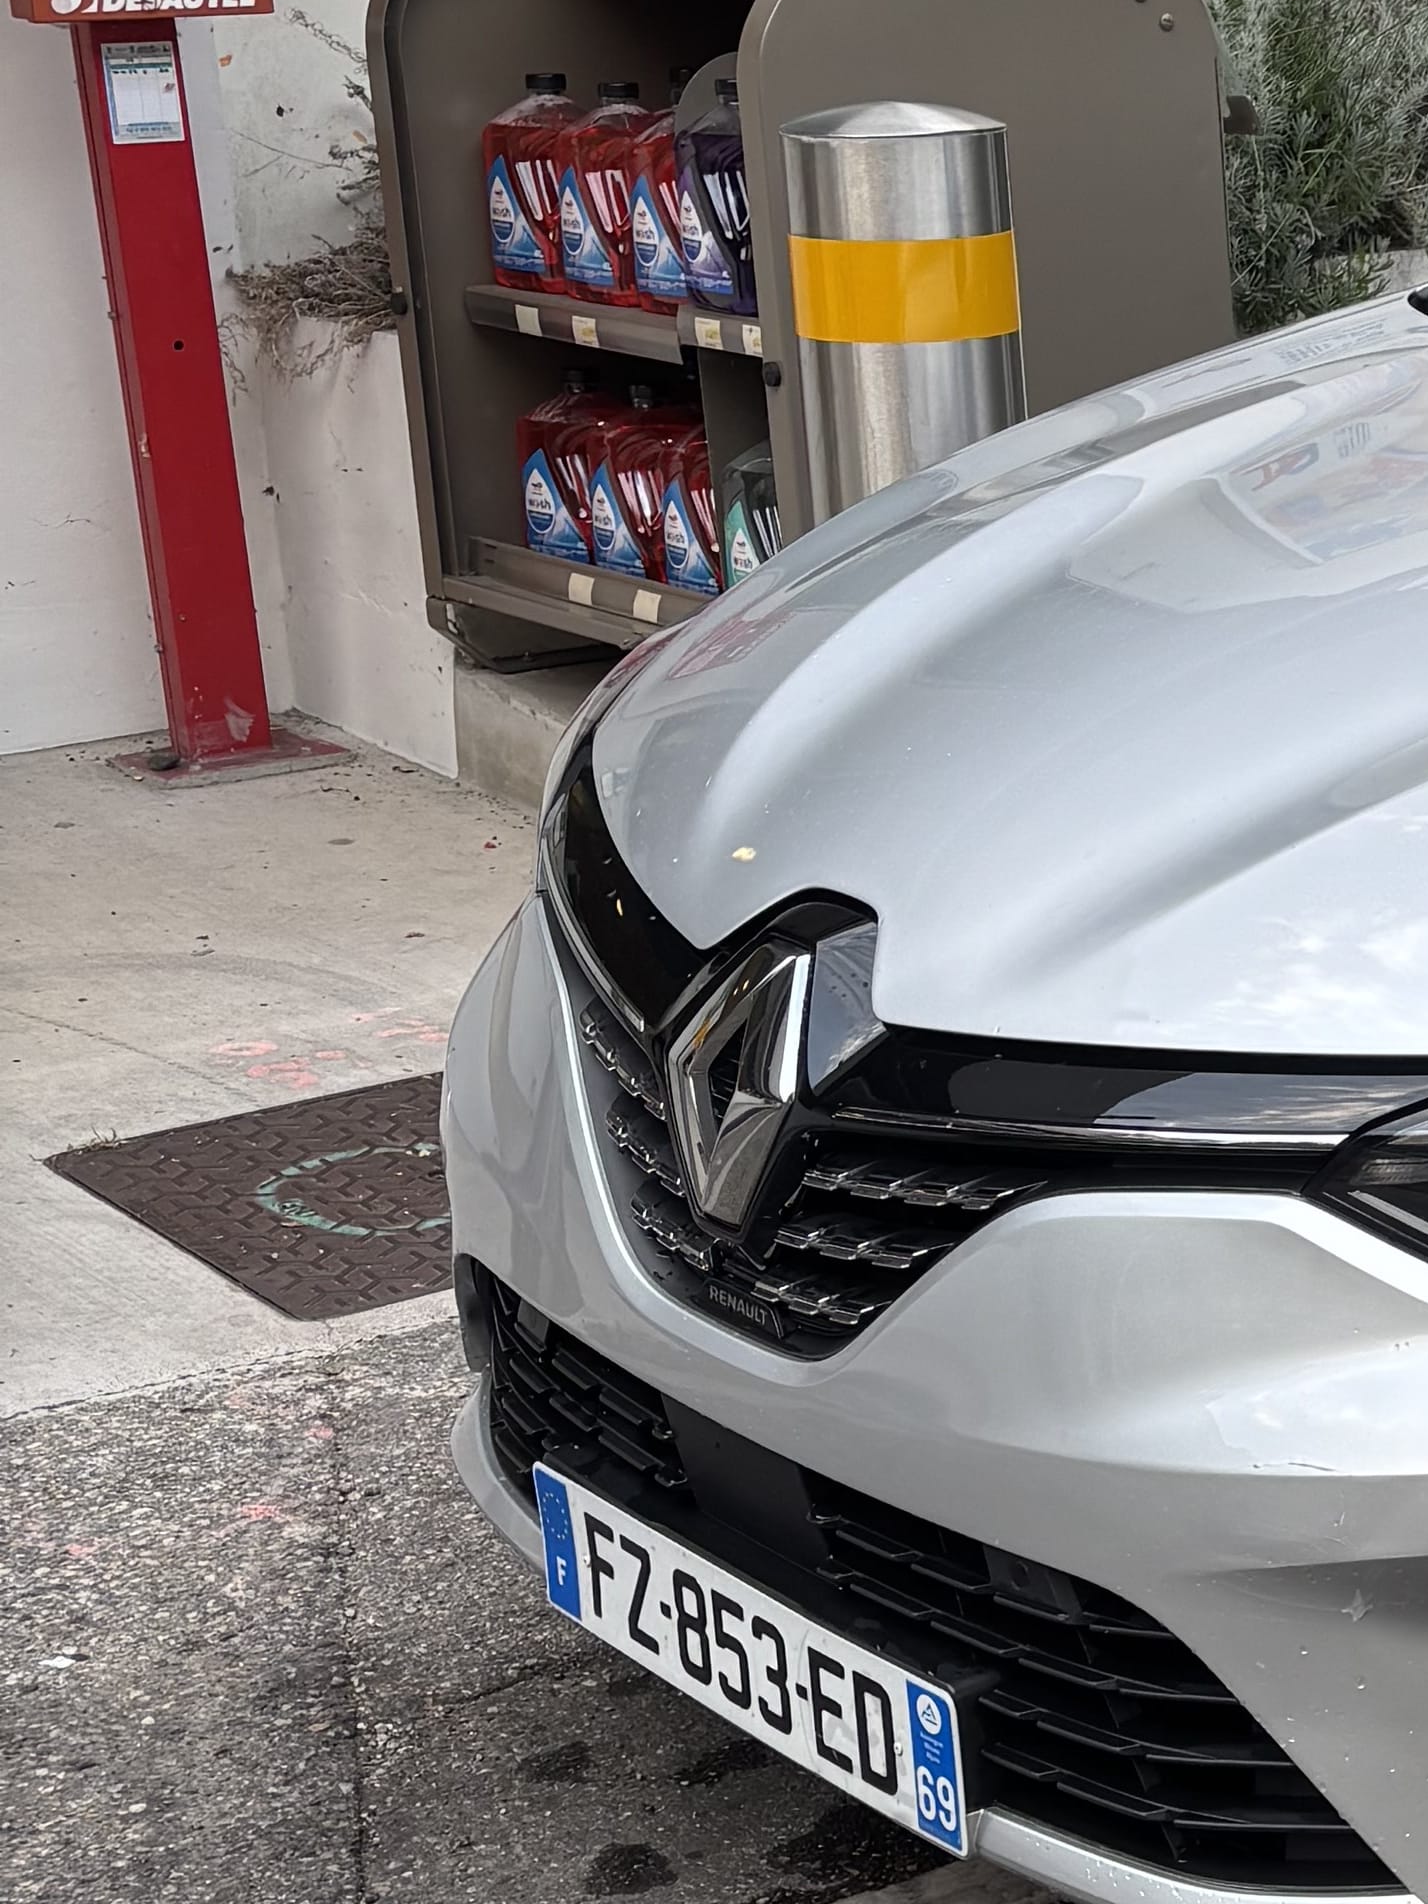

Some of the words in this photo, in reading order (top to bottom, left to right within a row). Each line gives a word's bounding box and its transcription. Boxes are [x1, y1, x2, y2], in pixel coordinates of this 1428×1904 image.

[709, 1285, 768, 1326] RENAULT
[556, 1556, 567, 1586] F
[584, 1512, 898, 1796] FZ-853-ED
[916, 1765, 957, 1832] 69
